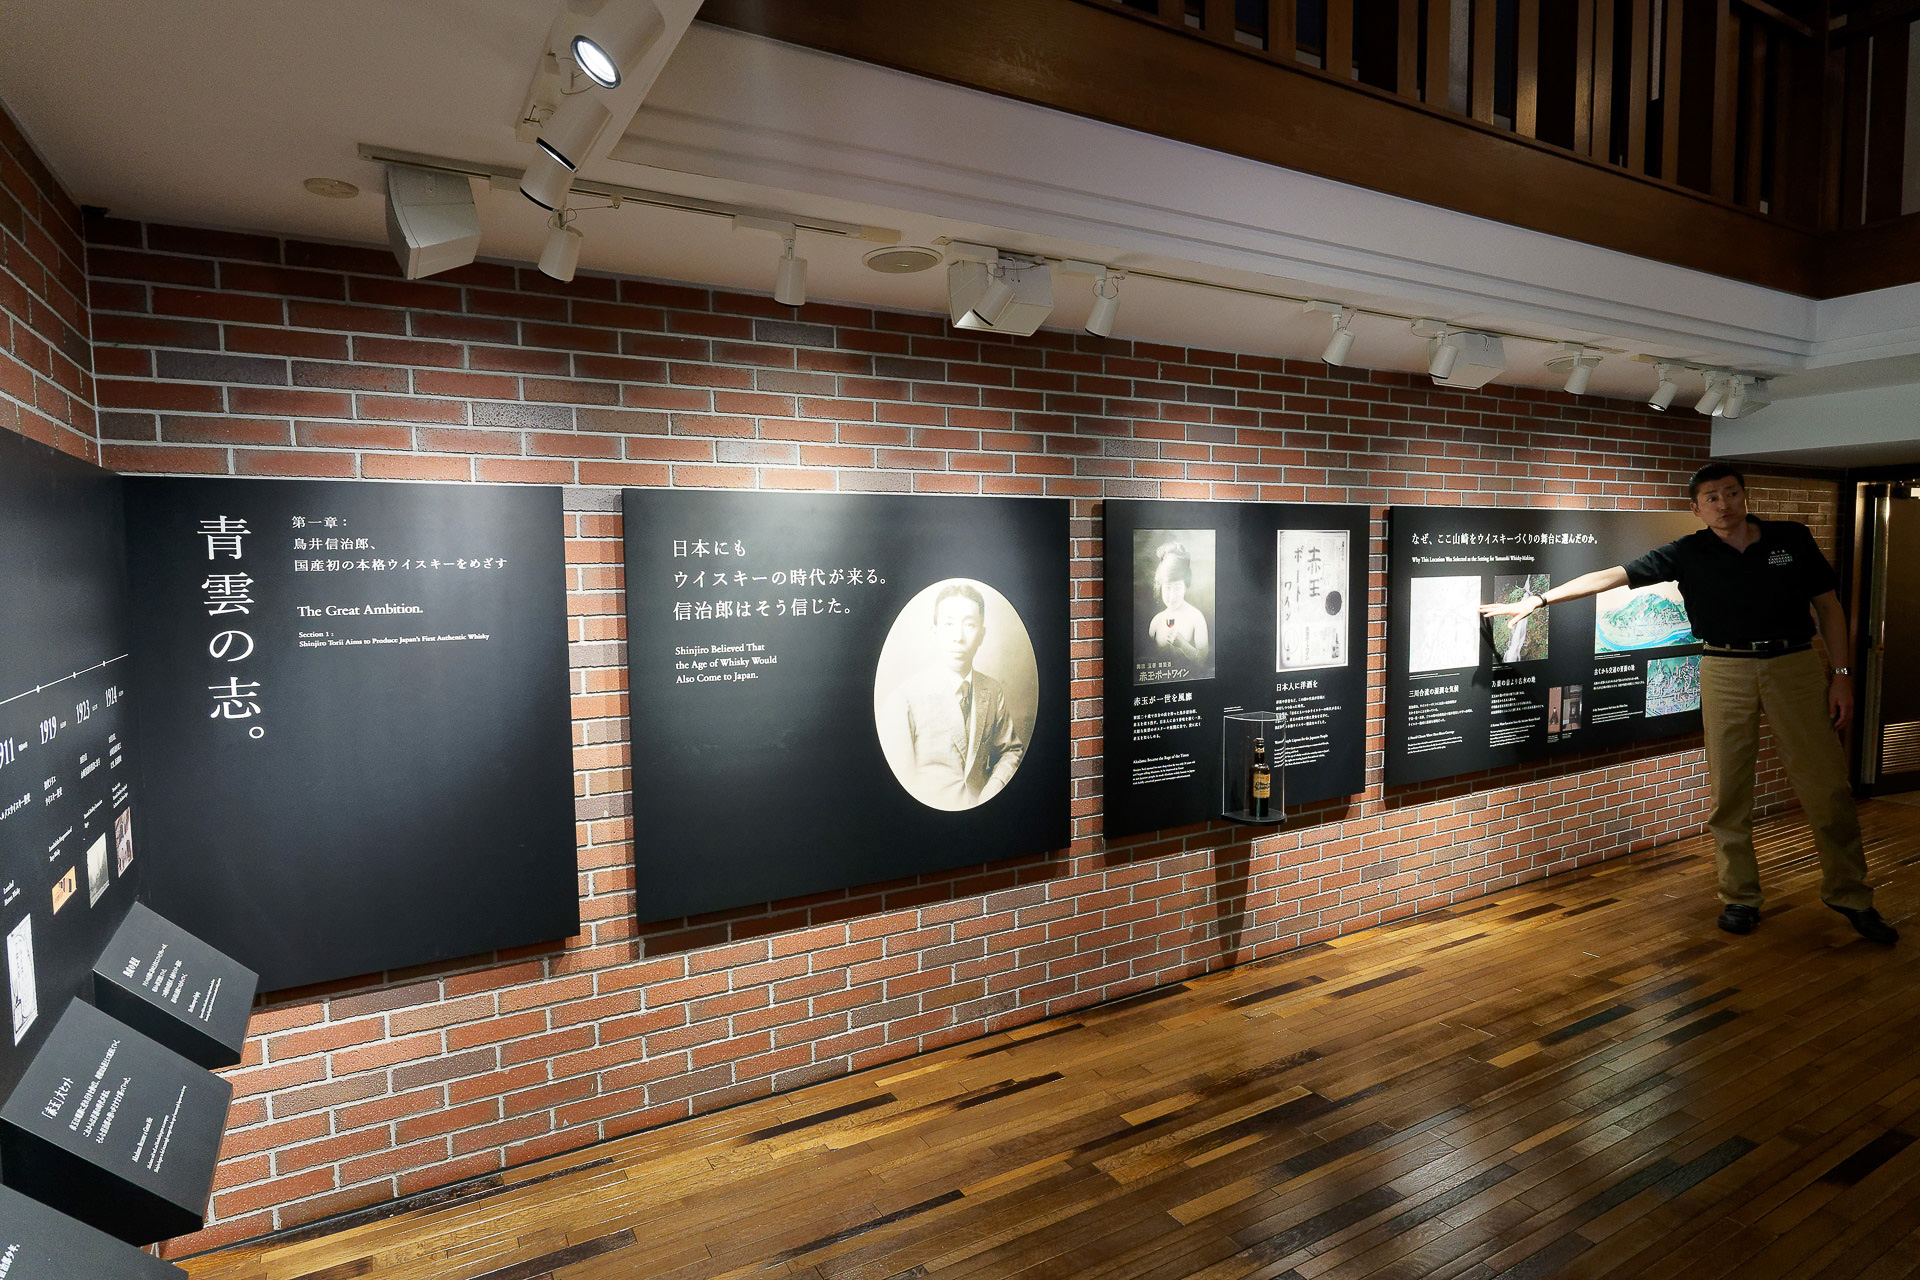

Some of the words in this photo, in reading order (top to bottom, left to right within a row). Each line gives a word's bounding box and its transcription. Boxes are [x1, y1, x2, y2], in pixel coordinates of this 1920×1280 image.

[294, 537, 377, 550] 鳥井信治郎、
[673, 538, 746, 558] 日本にも
[294, 558, 507, 572] 国産初の本格ウイスキーをめざす
[674, 568, 887, 588] ウイスキーの時代が来る。
[298, 606, 322, 618] The
[326, 604, 360, 616] Great
[363, 603, 423, 615] Ambition.
[673, 598, 851, 620] 信治郎はそう信じた。
[197, 515, 264, 739] 青雲の志。
[675, 646, 709, 656] Shinjiro
[711, 643, 744, 654] Believed
[746, 643, 765, 651] That
[676, 661, 689, 669] the
[691, 660, 707, 670] Age
[709, 658, 719, 667] of
[720, 657, 750, 667] Whisky
[751, 655, 777, 664] Would
[676, 675, 695, 683] Also
[697, 673, 721, 682] Come
[733, 672, 758, 682] Japan.
[1276, 680, 1318, 691] 日本人に洋酒を
[106, 685, 118, 708] 1924
[76, 699, 90, 724] 1923
[40, 716, 57, 745] 1919
